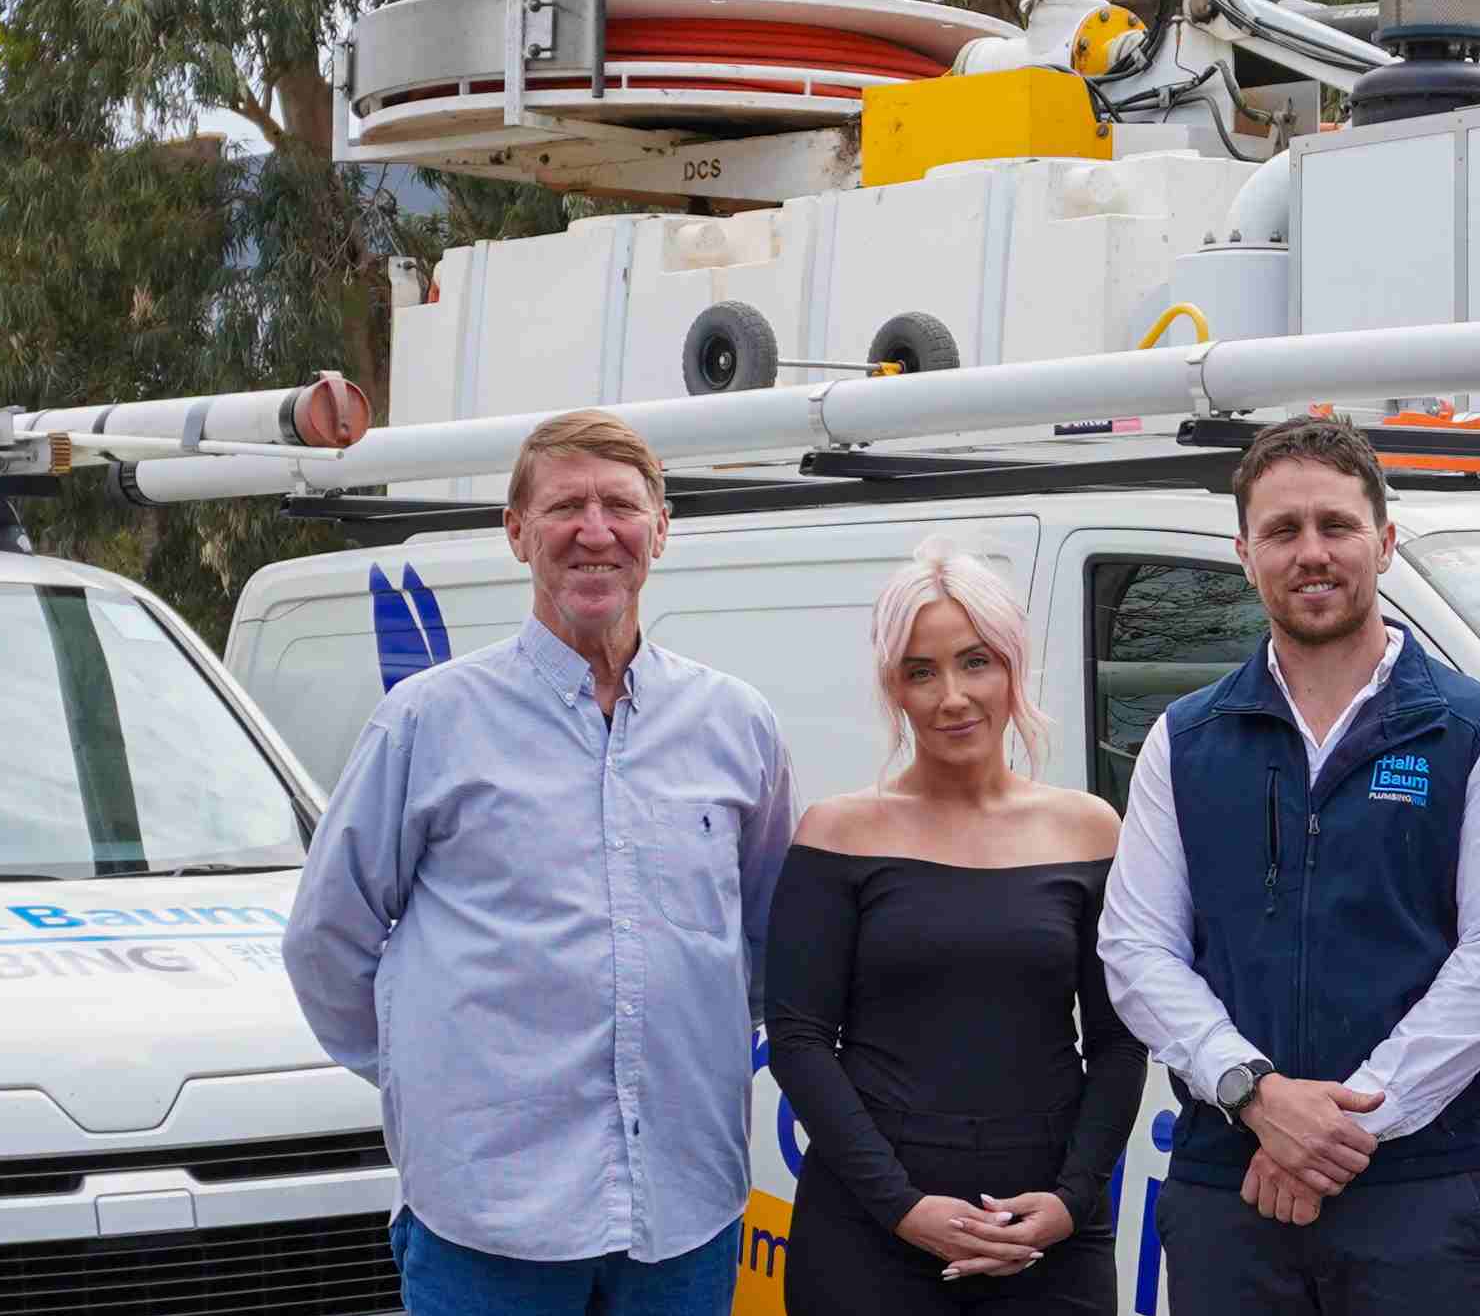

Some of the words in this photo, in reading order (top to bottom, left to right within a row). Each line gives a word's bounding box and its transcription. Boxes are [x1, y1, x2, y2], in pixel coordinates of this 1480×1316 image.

[683, 158, 722, 182] DCS
[1379, 770, 1429, 789] Baum
[4, 903, 290, 930] Baum
